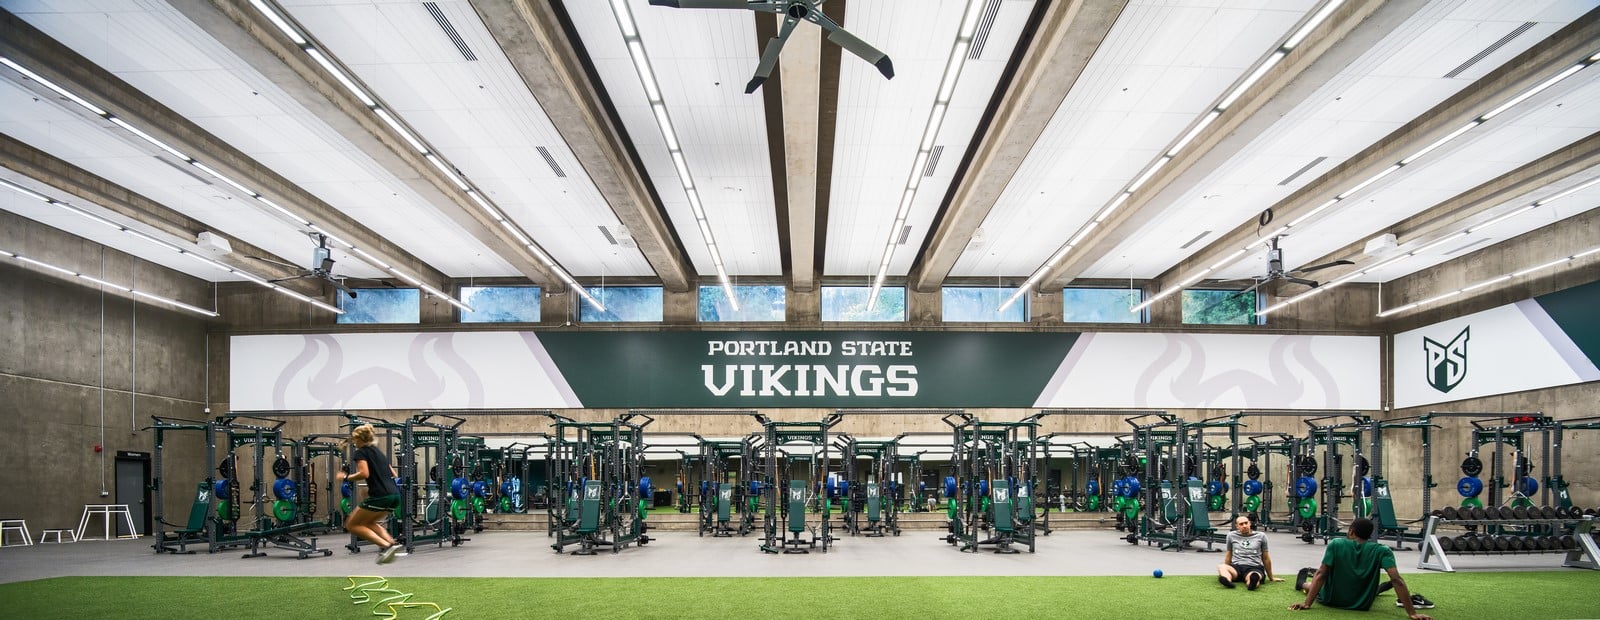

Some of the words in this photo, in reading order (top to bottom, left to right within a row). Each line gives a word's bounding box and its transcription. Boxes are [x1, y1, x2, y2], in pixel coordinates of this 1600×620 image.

[708, 340, 832, 356] PORTLAND
[841, 340, 913, 356] STATE
[1424, 325, 1470, 393] PS
[701, 364, 919, 397] VIKINGS
